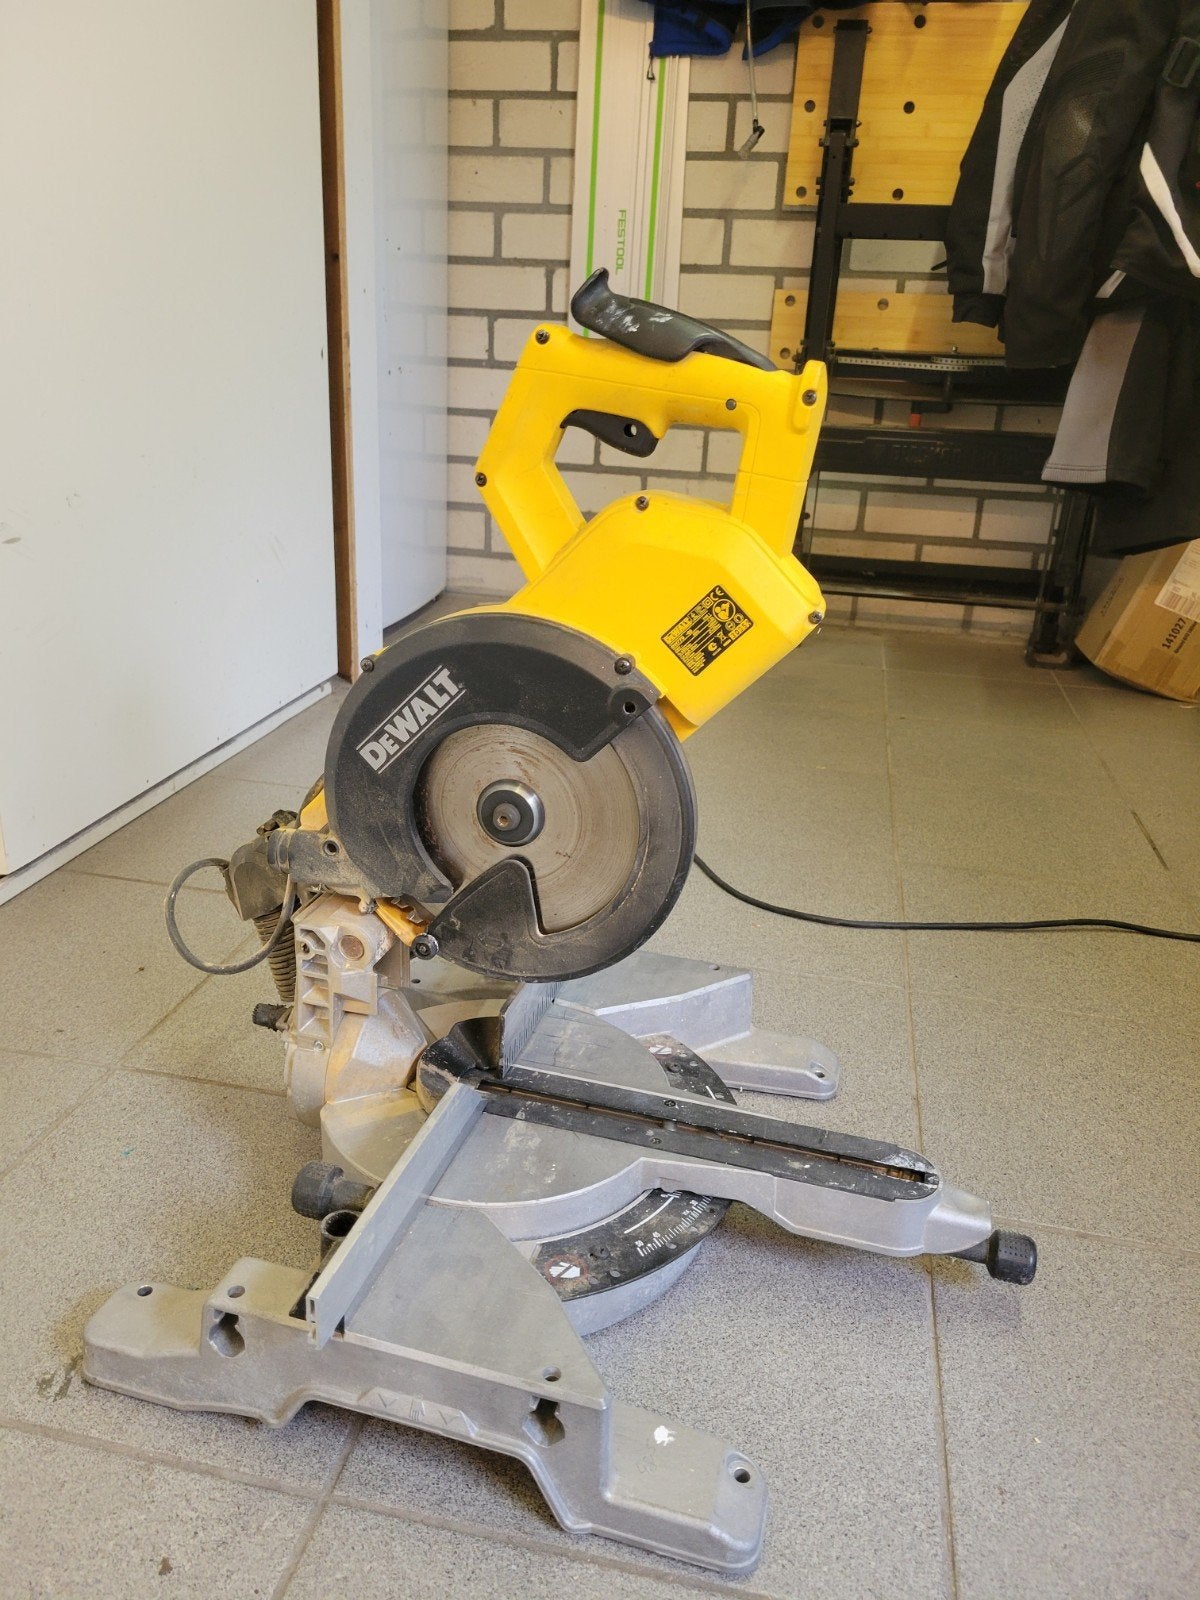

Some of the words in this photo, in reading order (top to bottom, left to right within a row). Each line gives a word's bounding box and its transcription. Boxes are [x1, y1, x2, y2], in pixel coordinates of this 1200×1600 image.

[615, 209, 627, 275] FESTOOL
[1162, 617, 1187, 650] 141027
[359, 668, 459, 770] DEWALT
